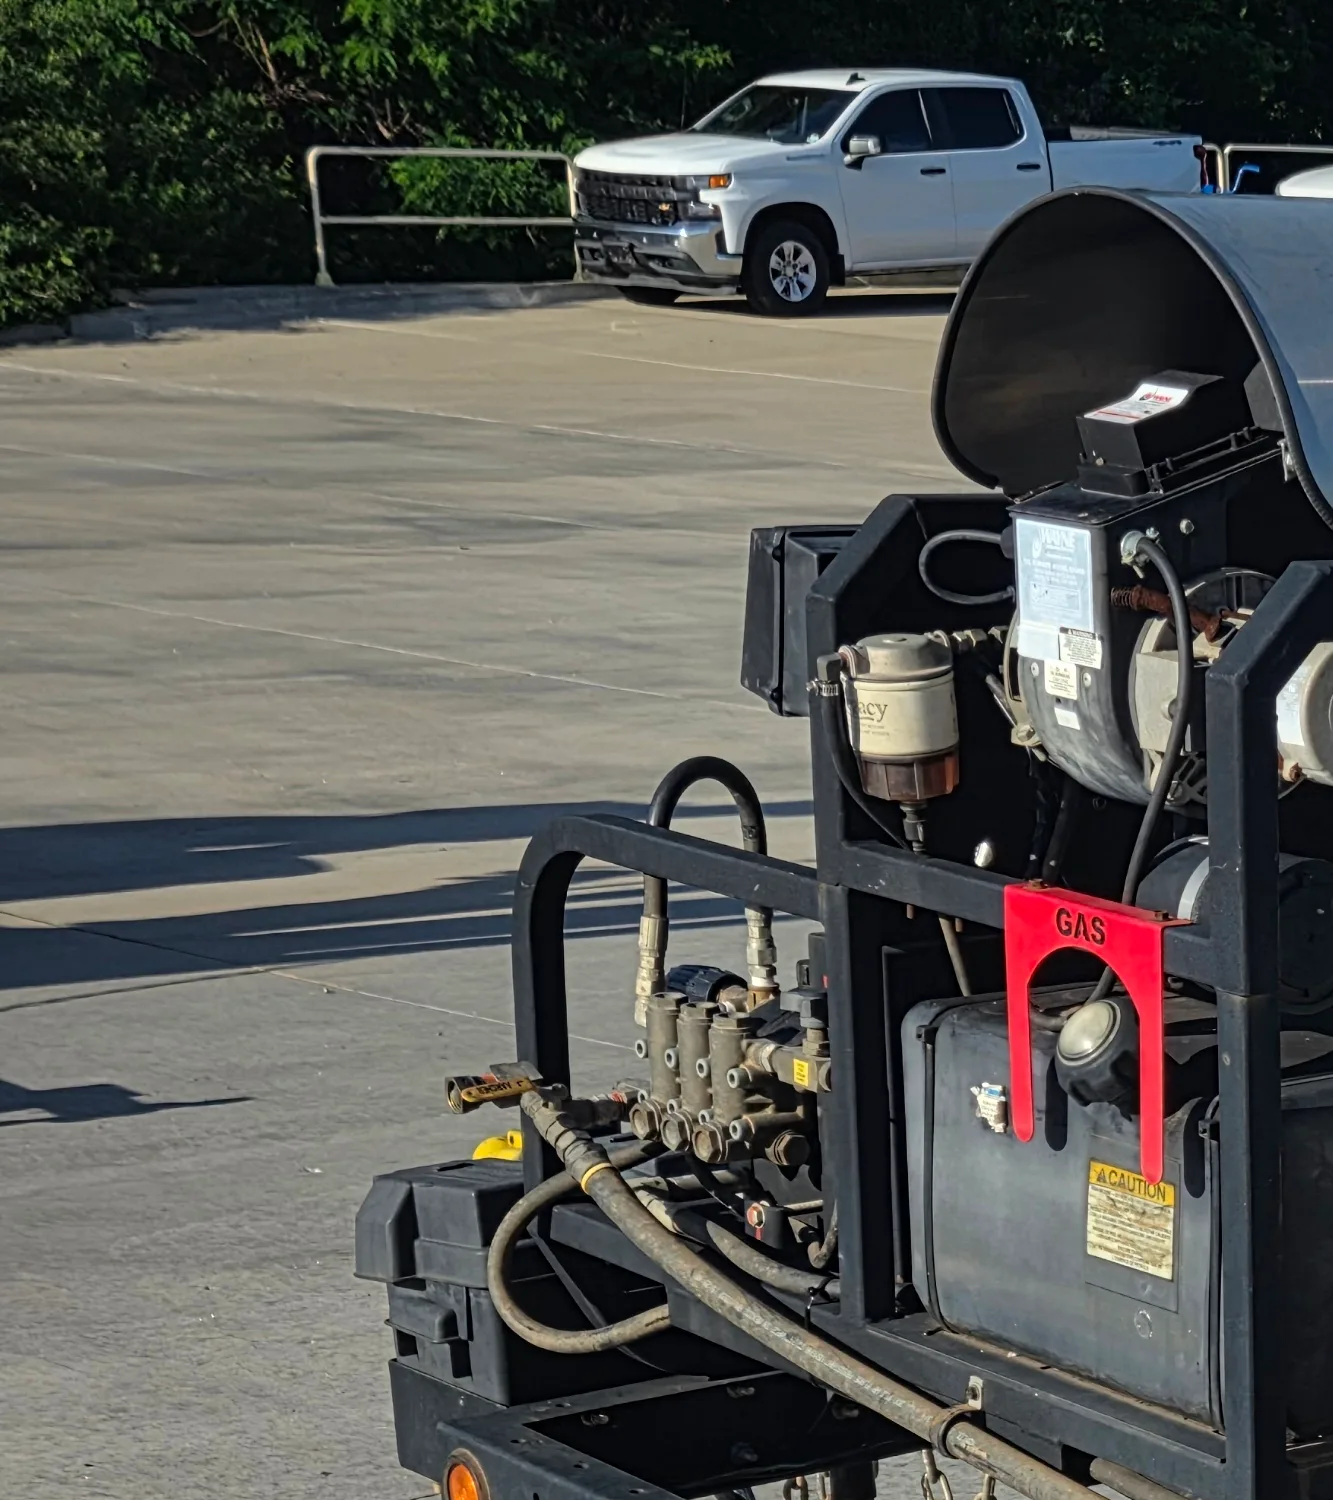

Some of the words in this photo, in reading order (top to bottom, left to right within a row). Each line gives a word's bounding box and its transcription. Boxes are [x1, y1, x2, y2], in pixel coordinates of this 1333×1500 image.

[858, 701, 888, 722] acy
[1055, 907, 1106, 945] GAS
[1108, 1170, 1166, 1202] CAUTION
